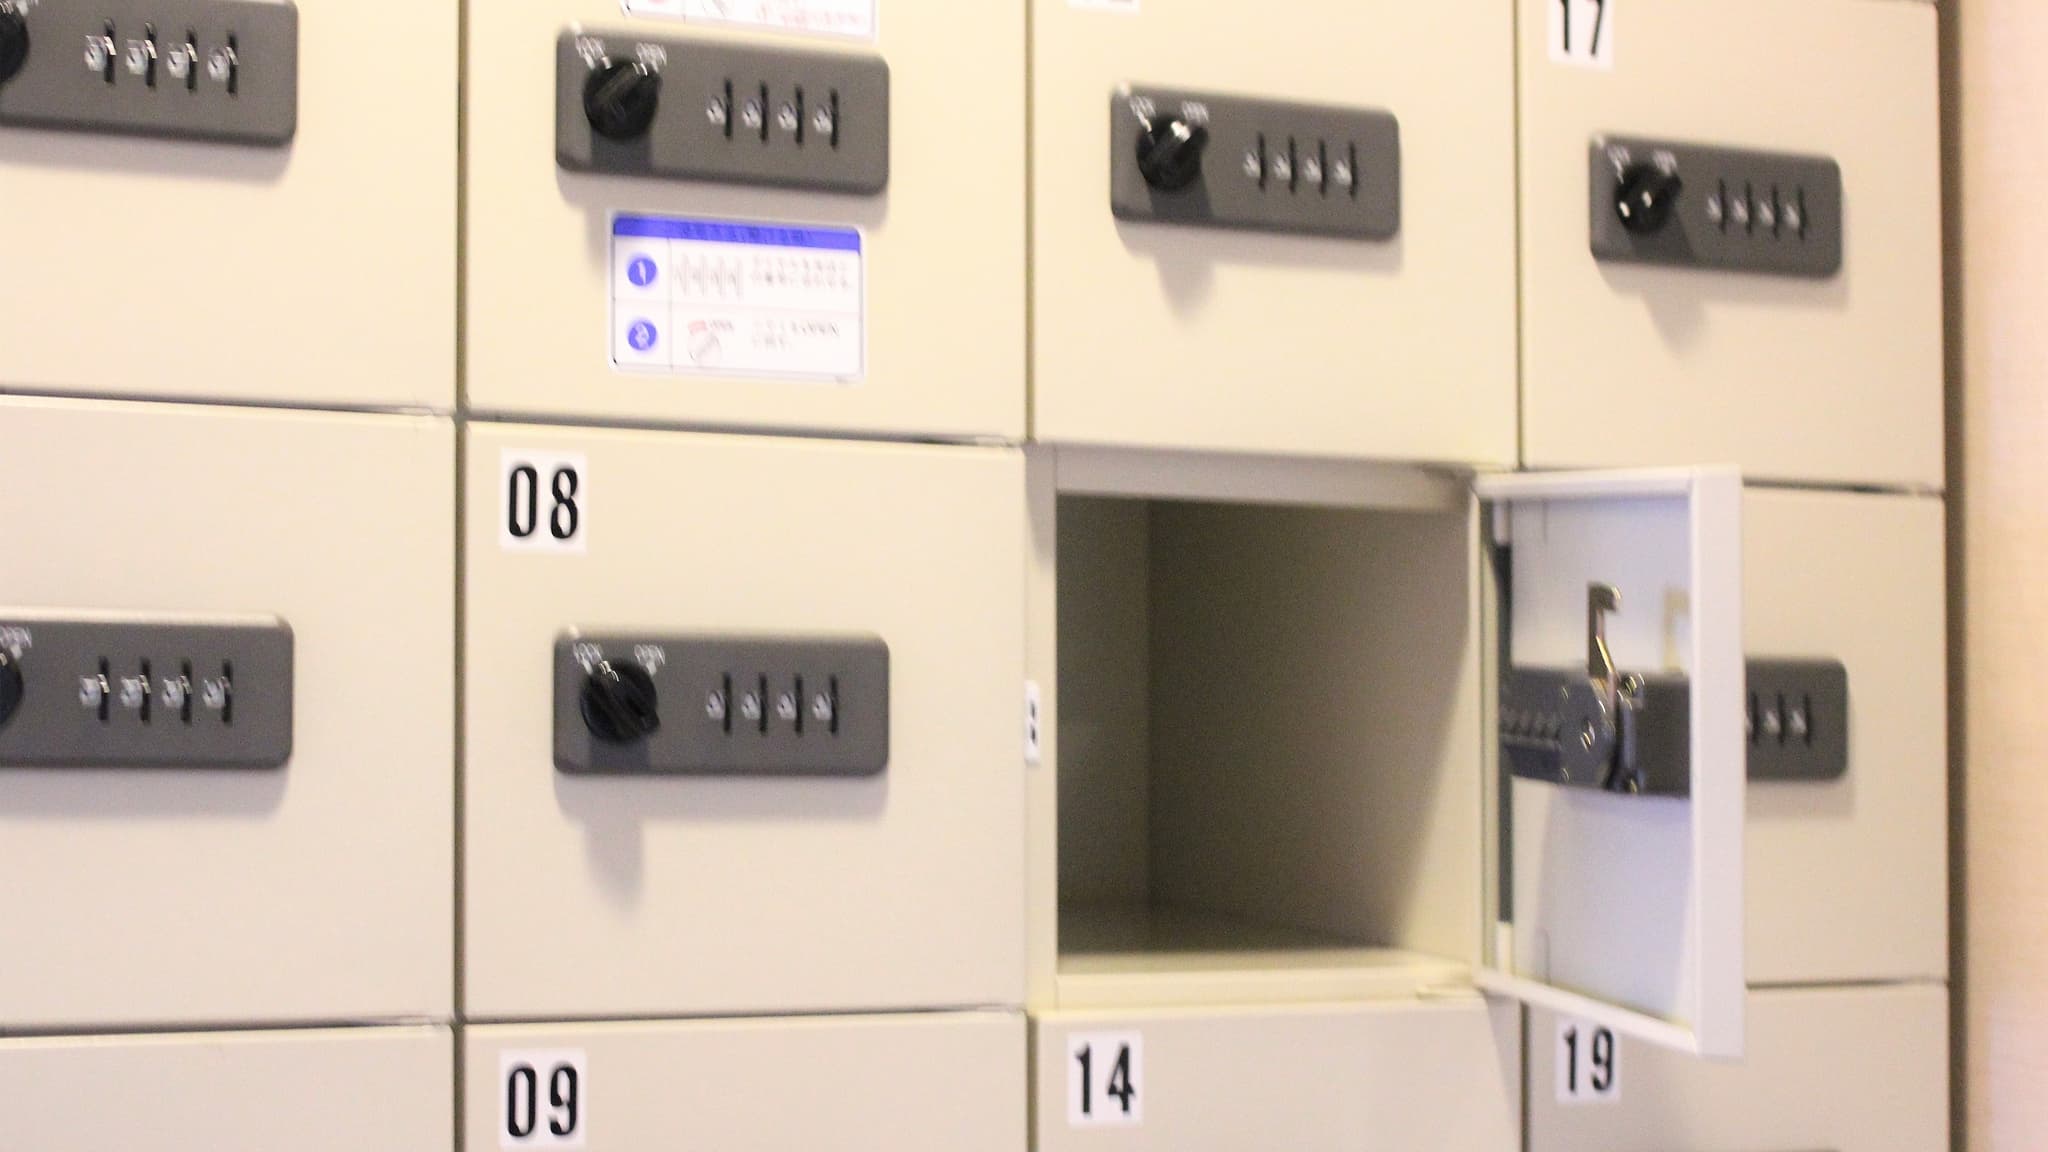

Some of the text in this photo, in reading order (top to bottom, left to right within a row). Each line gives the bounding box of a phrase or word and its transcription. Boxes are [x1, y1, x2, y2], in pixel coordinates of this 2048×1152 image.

[1560, 0, 1604, 56] 17
[508, 465, 578, 540] 08
[1077, 1045, 1135, 1114] 14
[1565, 1028, 1614, 1092] 19
[507, 1064, 578, 1138] 09
